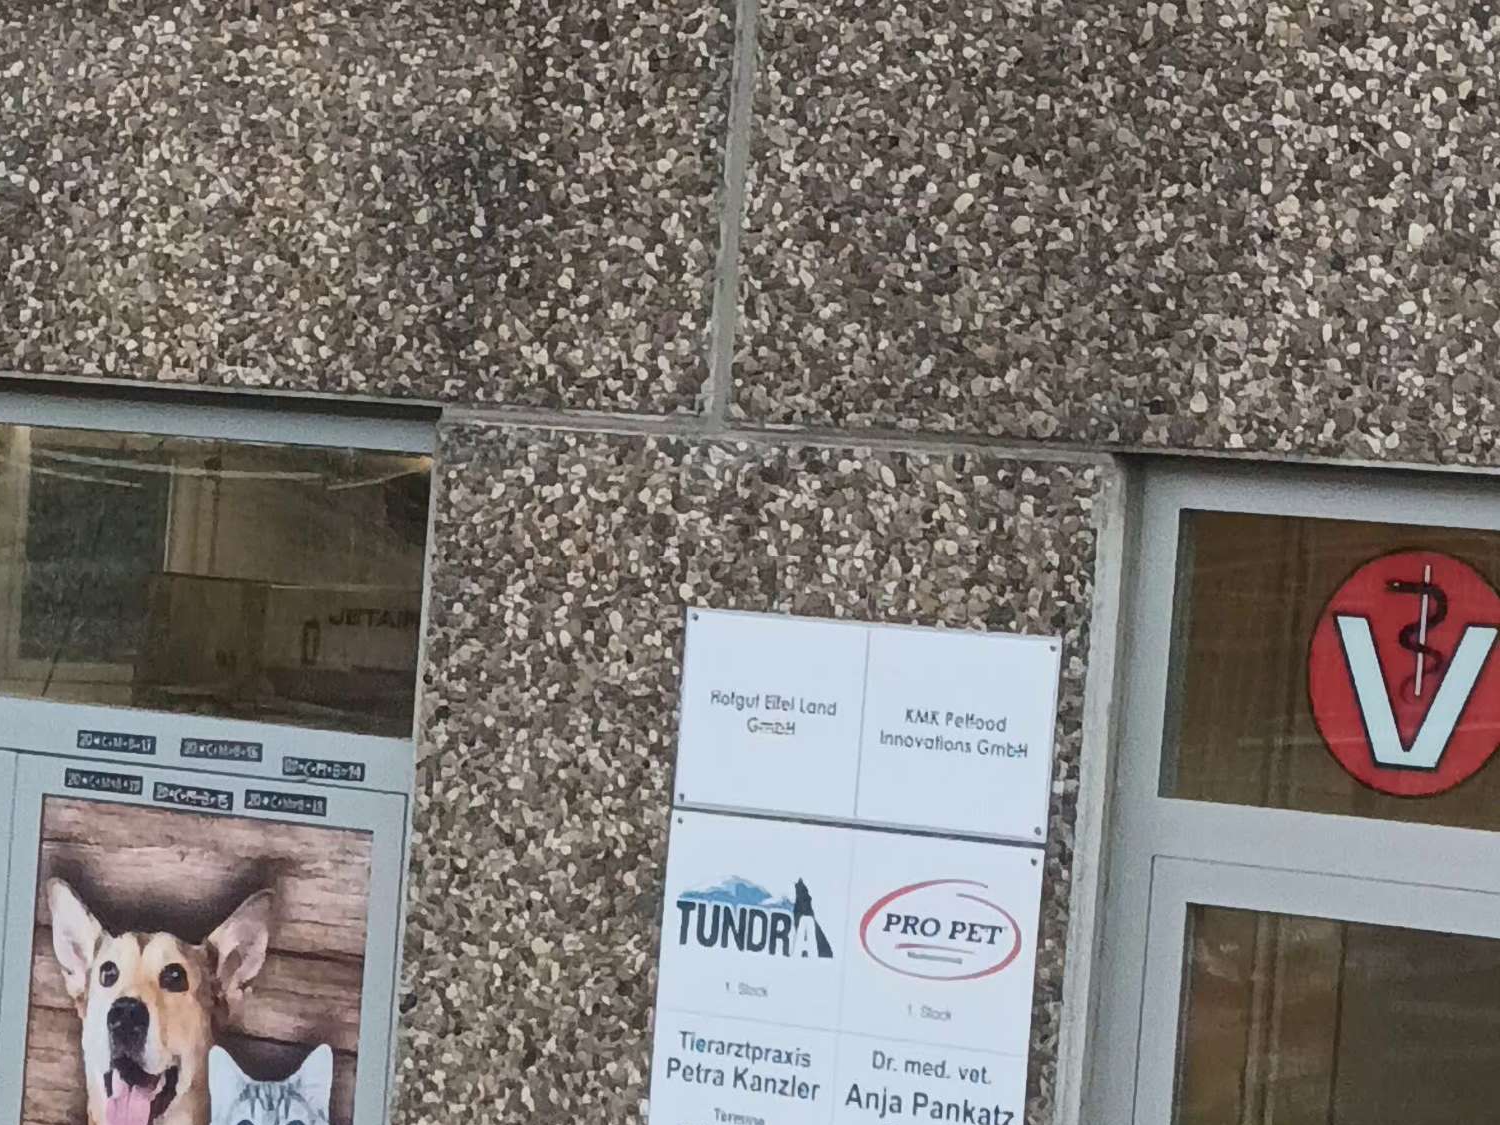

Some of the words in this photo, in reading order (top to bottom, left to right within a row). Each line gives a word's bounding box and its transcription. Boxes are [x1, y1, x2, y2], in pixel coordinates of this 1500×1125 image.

[800, 698, 837, 716] Land
[905, 708, 940, 726] KMK
[945, 711, 1007, 732] Petfood
[880, 730, 972, 753] Innovations
[977, 739, 1028, 758] GmbH
[676, 877, 833, 959] TUNDRA
[883, 912, 941, 937] PRO
[949, 920, 1004, 946] PET
[738, 982, 769, 998] Stock
[920, 1005, 953, 1022] Stock
[679, 1031, 812, 1068] Tierarztpraxis
[666, 1057, 725, 1086] Petra
[733, 1066, 821, 1101] Kanzler
[872, 1050, 897, 1071] Dr.
[904, 1059, 950, 1079] med.
[958, 1066, 992, 1084] vet.
[845, 1083, 902, 1119] Anja
